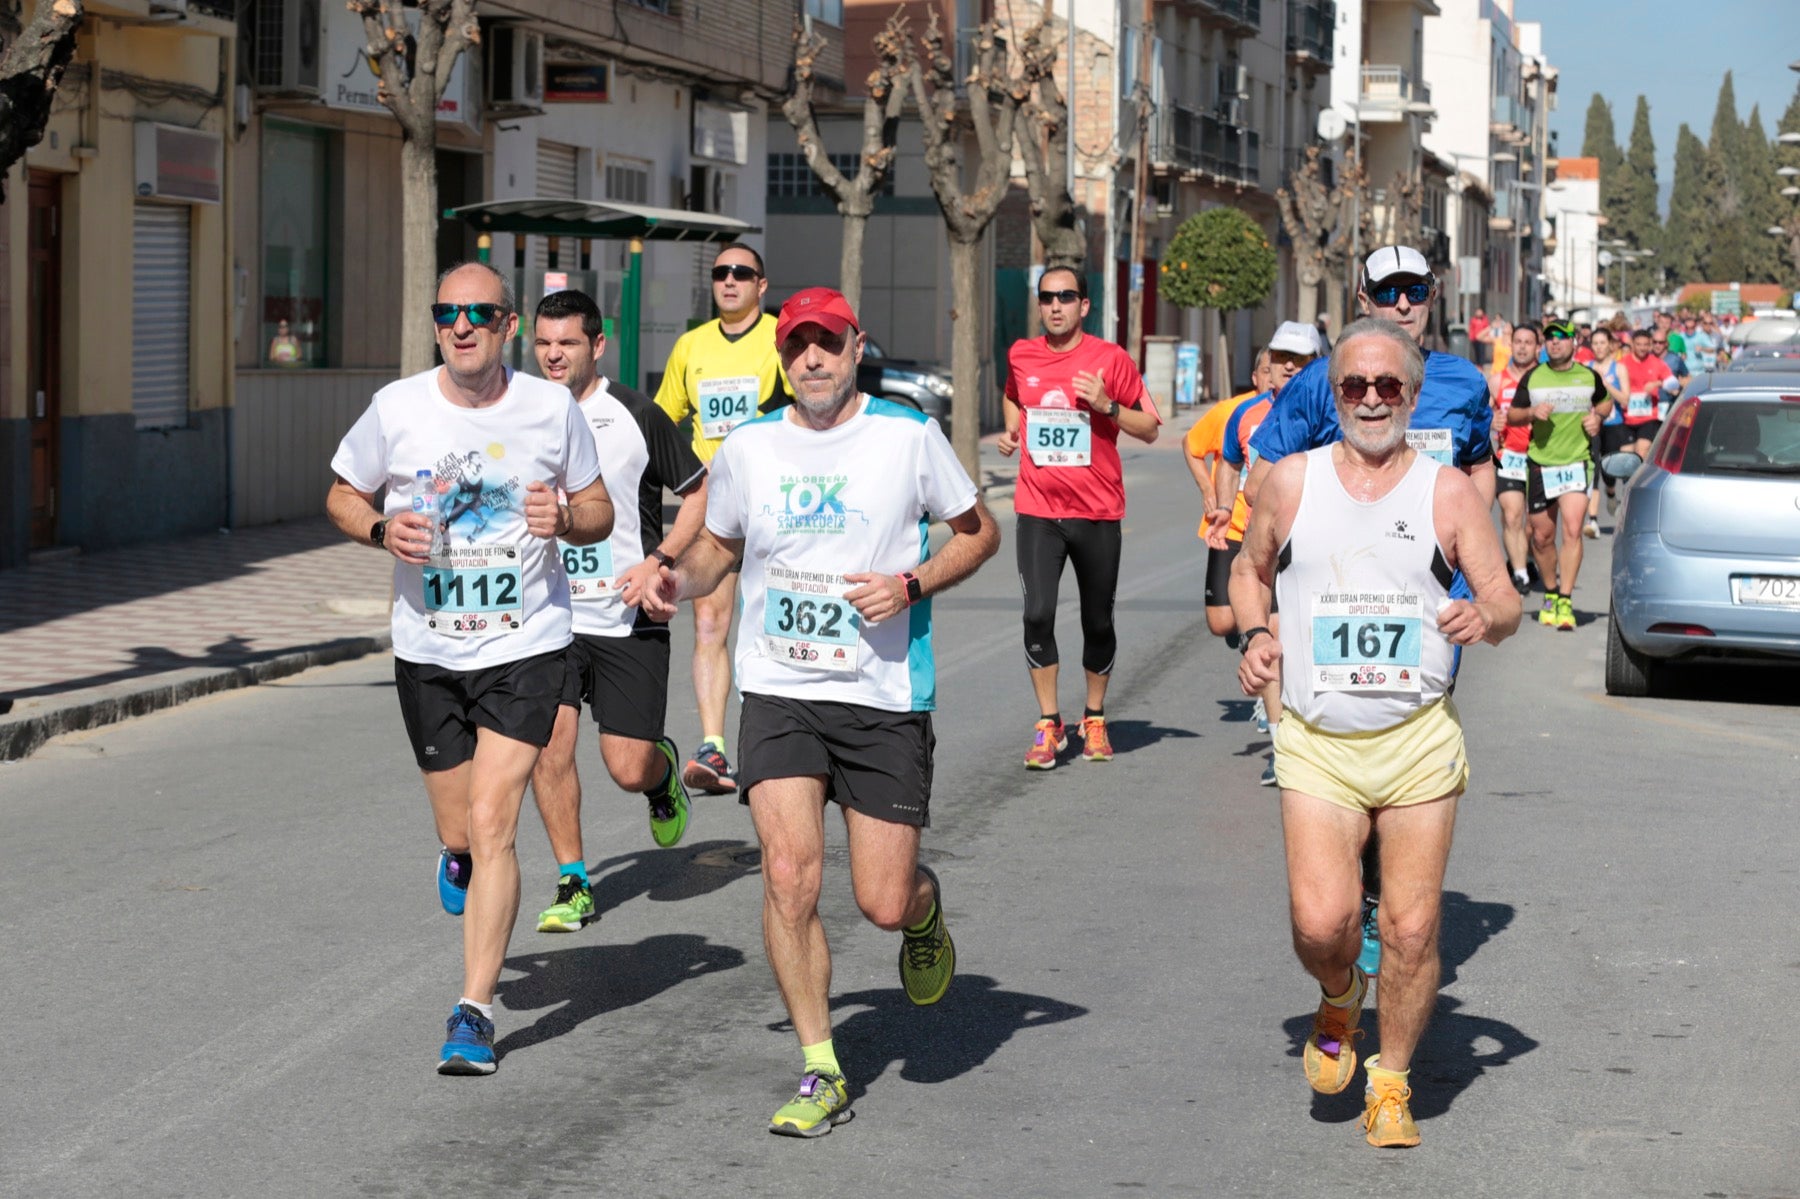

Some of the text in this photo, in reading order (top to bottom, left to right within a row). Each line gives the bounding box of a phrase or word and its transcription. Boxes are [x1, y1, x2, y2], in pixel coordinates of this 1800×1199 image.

[708, 394, 748, 418] 904
[1038, 427, 1080, 447] 587
[1406, 431, 1423, 440] REMIO
[780, 475, 848, 483] SALOBREÑA
[777, 514, 846, 522] CAMPEONATO
[778, 520, 845, 529] ANDALUCÍA
[1385, 531, 1415, 542] KELME
[460, 548, 483, 558] PREMIO
[484, 548, 492, 557] DE
[450, 558, 488, 567] DIPUTACIÓN
[785, 569, 799, 580] GRAN
[800, 572, 824, 583] PREMIO
[826, 574, 835, 584] DE
[428, 572, 517, 607] 1112
[791, 581, 828, 594] DIPUTACIÓN
[1339, 594, 1358, 603] GRAN
[1360, 594, 1385, 603] PREMIO
[1386, 594, 1395, 603] DE
[1396, 595, 1418, 605] FONDO
[1349, 605, 1390, 614] DIPUTACIÓN
[778, 597, 842, 638] 362
[1332, 622, 1406, 658] 167
